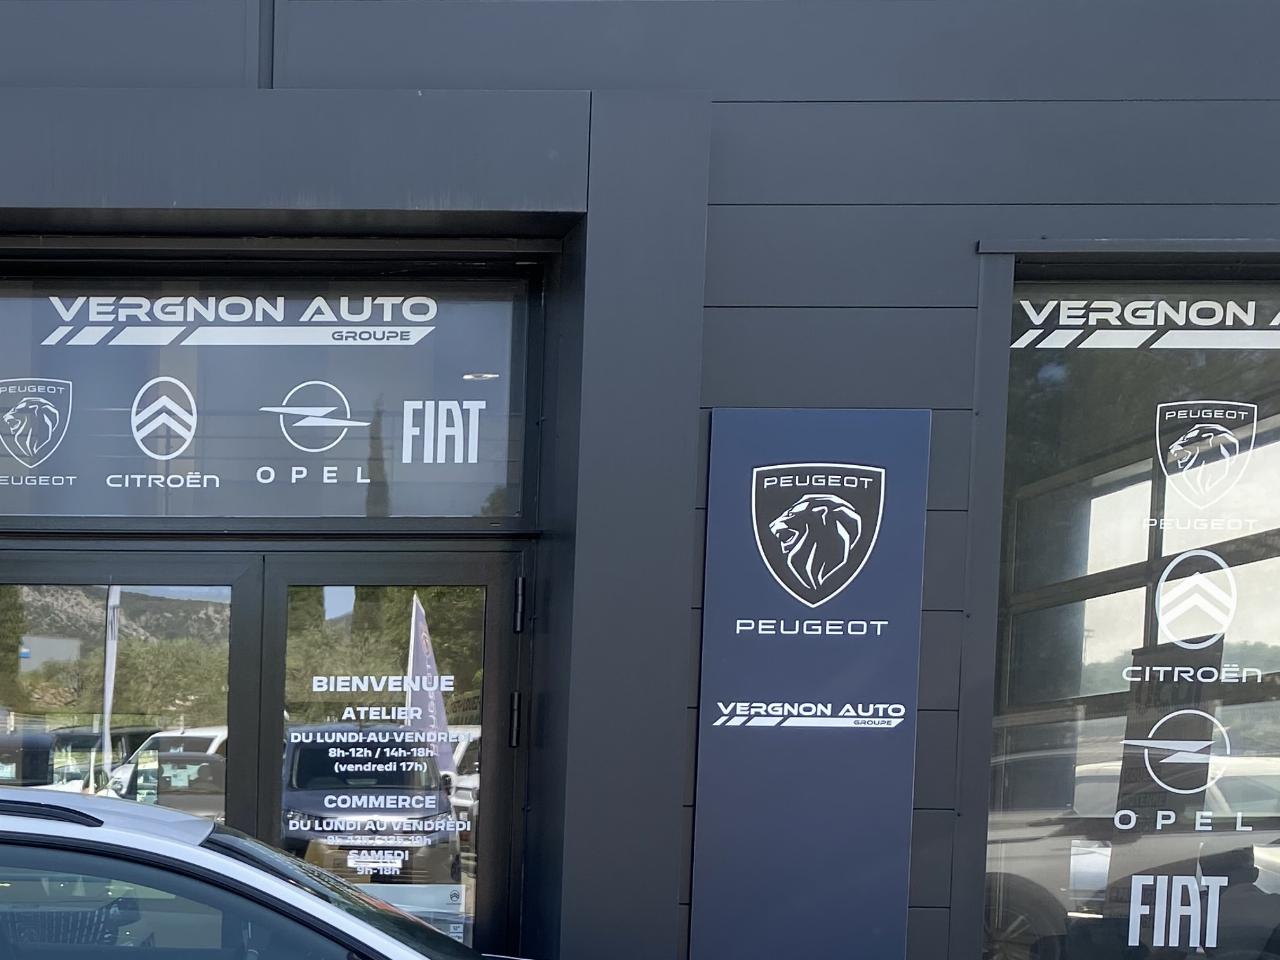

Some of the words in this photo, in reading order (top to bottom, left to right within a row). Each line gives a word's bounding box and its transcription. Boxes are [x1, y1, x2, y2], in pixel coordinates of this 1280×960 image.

[48, 297, 284, 322] VERGNON
[299, 297, 438, 322] AUTO
[1020, 300, 1256, 326] VERGNON
[331, 330, 411, 342] GROUPE
[0, 385, 65, 395] PEUGEOT
[1165, 410, 1249, 421] PEUGEOT
[402, 400, 486, 464] FIAT
[256, 466, 371, 485] OPEL
[763, 475, 873, 488] PEUGEOT
[1143, 518, 1258, 530] PEUGEOT
[736, 619, 889, 635] PEUGEOT
[312, 675, 455, 692] BIENVENUE
[342, 706, 422, 720] ATELIER
[717, 701, 832, 716] VERGNON
[838, 703, 906, 717] AUTO
[290, 732, 314, 743] DU
[317, 732, 363, 743] LUNDI
[365, 732, 390, 743] AU
[393, 732, 474, 743] VENDREI
[328, 748, 372, 758] 8h-12h
[375, 748, 381, 758] /
[384, 748, 434, 758] 14h-18h
[334, 762, 397, 773] (vendredi
[400, 762, 428, 773] 17h)
[324, 795, 436, 808] COMMERCE
[288, 820, 310, 831] DU
[314, 820, 361, 831] LUNDI
[364, 820, 387, 831] AU
[391, 820, 471, 831] VENDREDI
[1114, 810, 1253, 831] OPEL
[348, 850, 409, 861] SAMEDI
[357, 866, 400, 875] 9h-18h
[1128, 875, 1229, 948] FIAT
